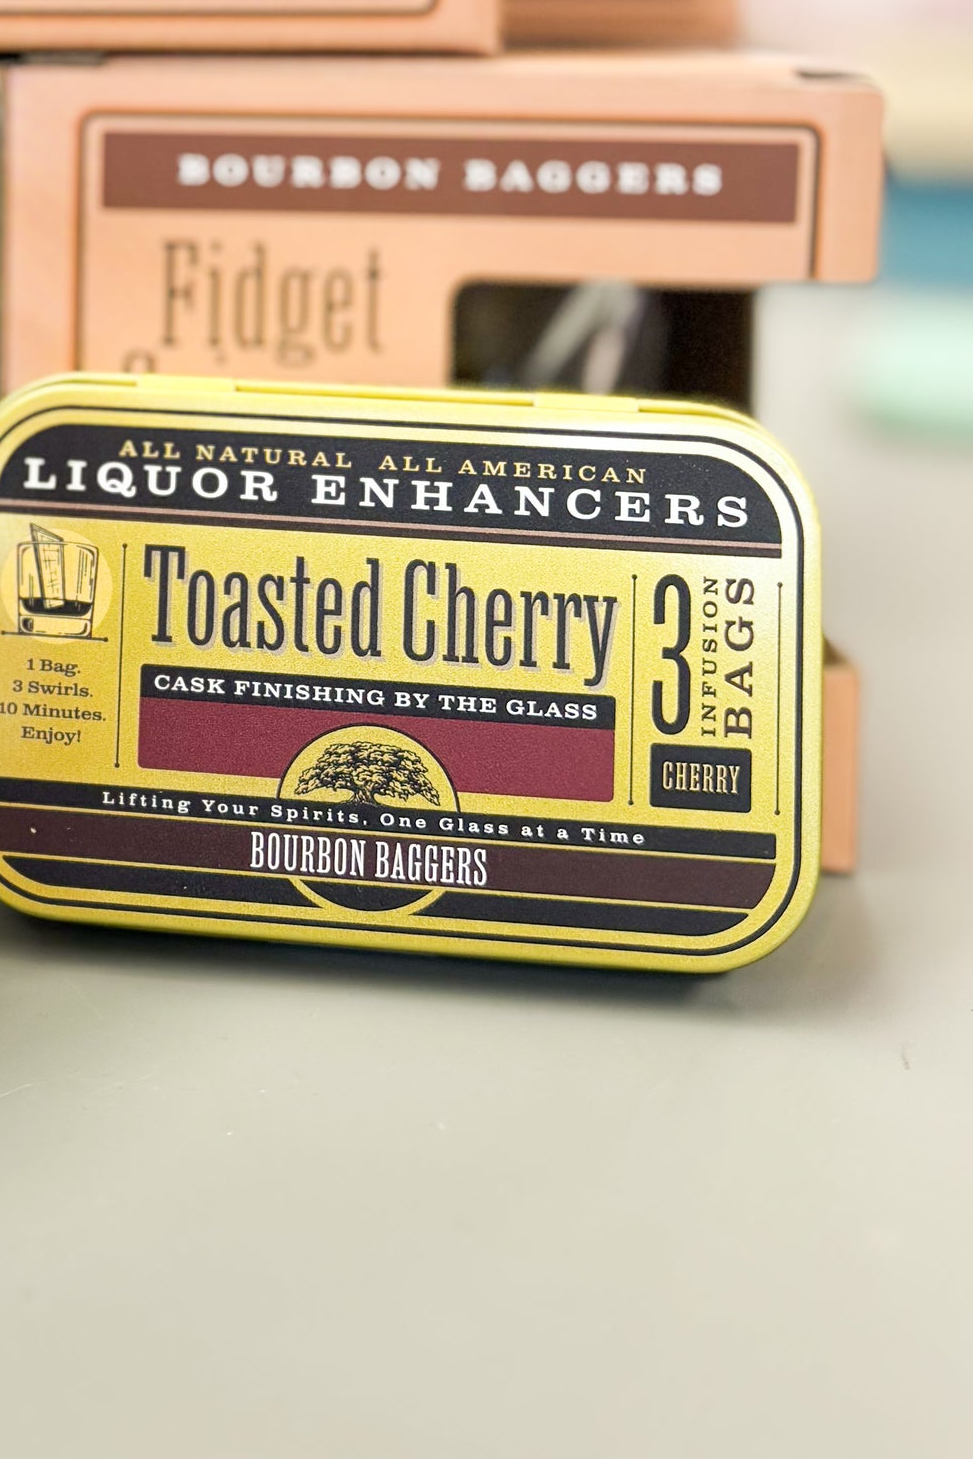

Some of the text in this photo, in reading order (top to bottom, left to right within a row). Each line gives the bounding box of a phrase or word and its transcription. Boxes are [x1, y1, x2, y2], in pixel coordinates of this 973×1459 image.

[177, 154, 724, 197] BOURBON BAGGERS
[161, 238, 385, 368] Fidget
[118, 440, 647, 485] ALL NATURAL ALL AMERICAN
[22, 457, 749, 529] LIQUOR ENHANCERS
[142, 543, 620, 689] Toasted Cherry
[27, 659, 82, 677] 1 Bag.
[651, 573, 691, 735] 3
[701, 576, 718, 737] INFUSION
[724, 577, 754, 739] BAGS
[12, 679, 93, 698] 3 Swirls.
[22, 702, 107, 722] Minutes.
[153, 674, 598, 721] CASK FINISHING BY THE GLASS
[20, 726, 82, 744] Enjoy!
[662, 760, 741, 795] CHERRY
[102, 791, 646, 845] Lifting Your Spirits, One Glass at a Time
[249, 831, 488, 887] BOURBON BAGGERS
